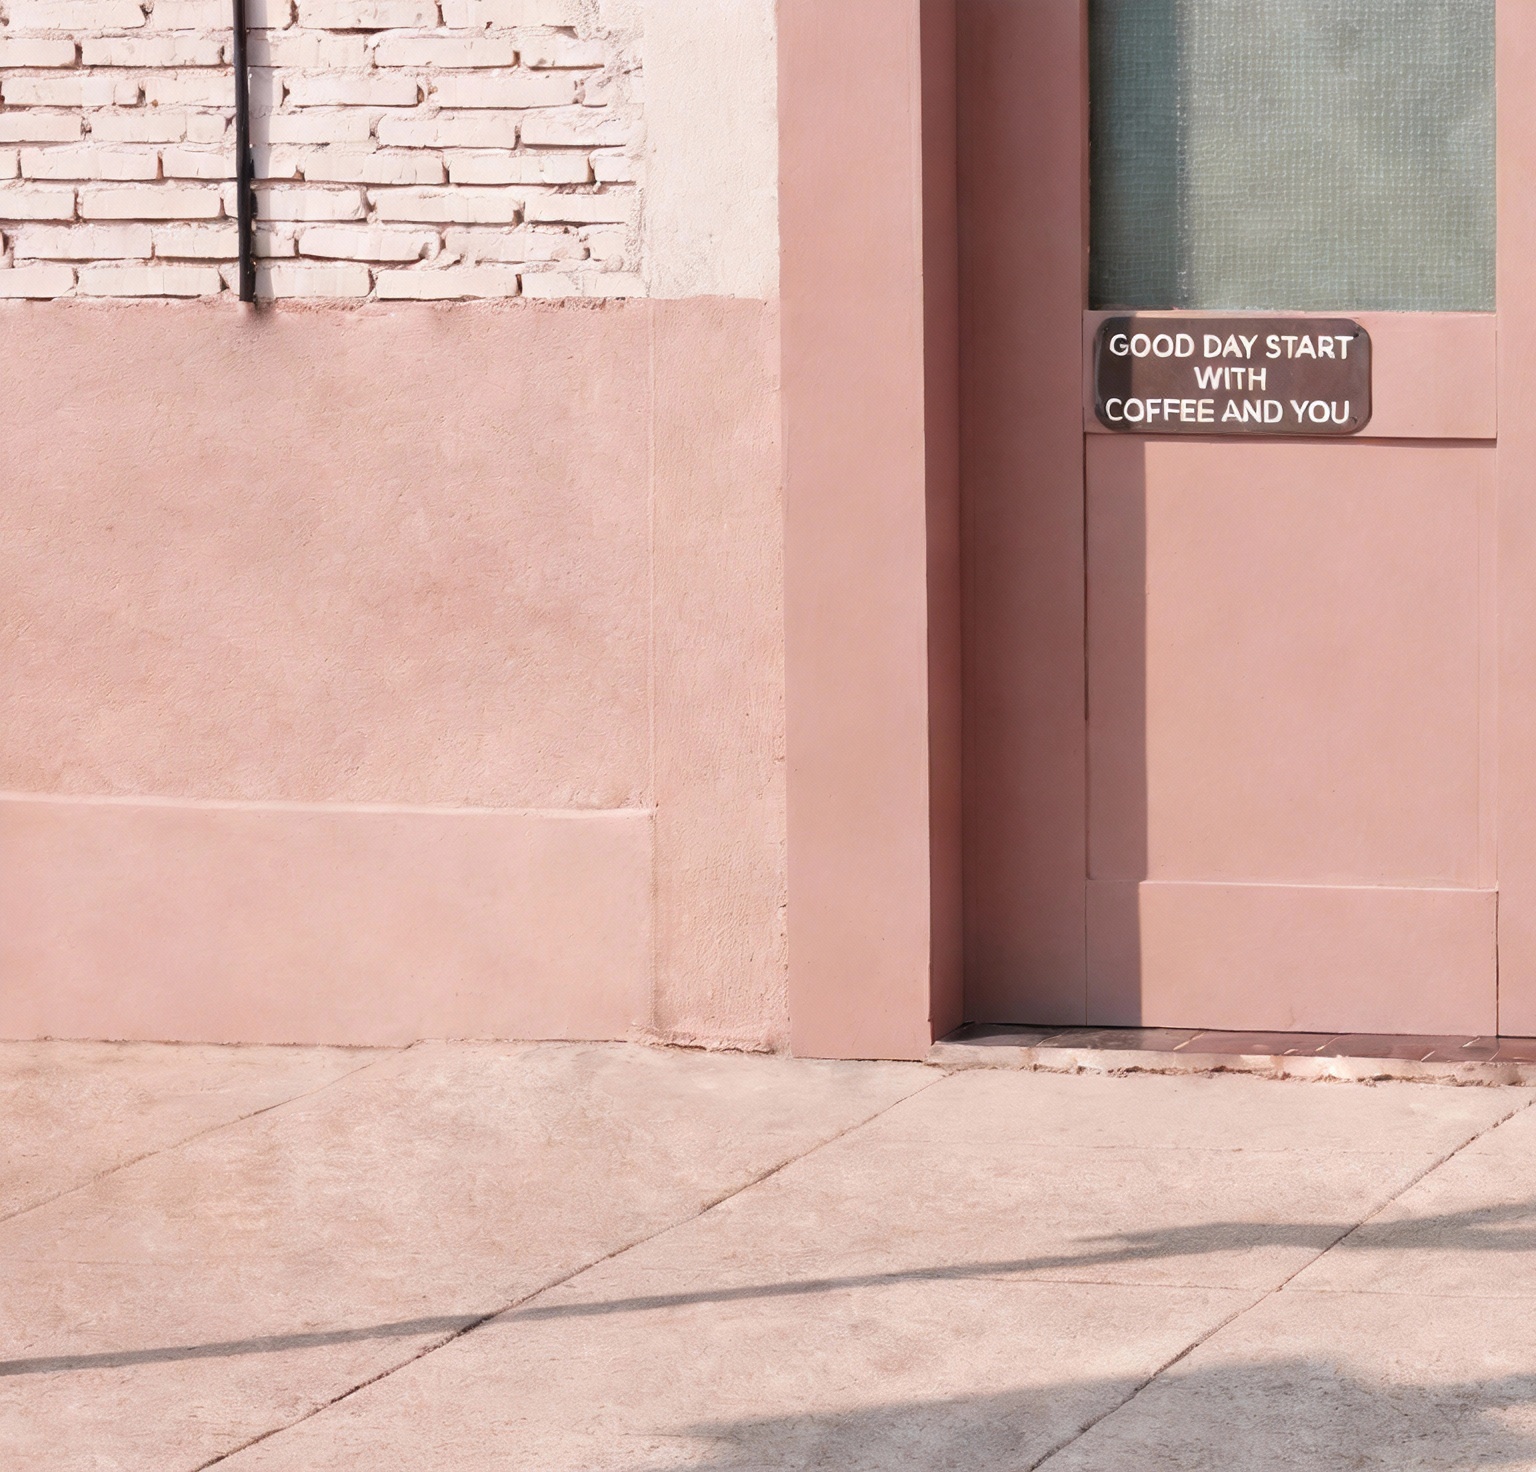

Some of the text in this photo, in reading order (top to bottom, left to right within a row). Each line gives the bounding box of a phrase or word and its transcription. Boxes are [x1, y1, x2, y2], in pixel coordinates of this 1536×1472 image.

[1109, 333, 1354, 359] GOOD DAY START
[1194, 366, 1267, 391] WITH
[1105, 398, 1350, 424] COFFEE AND YOU
